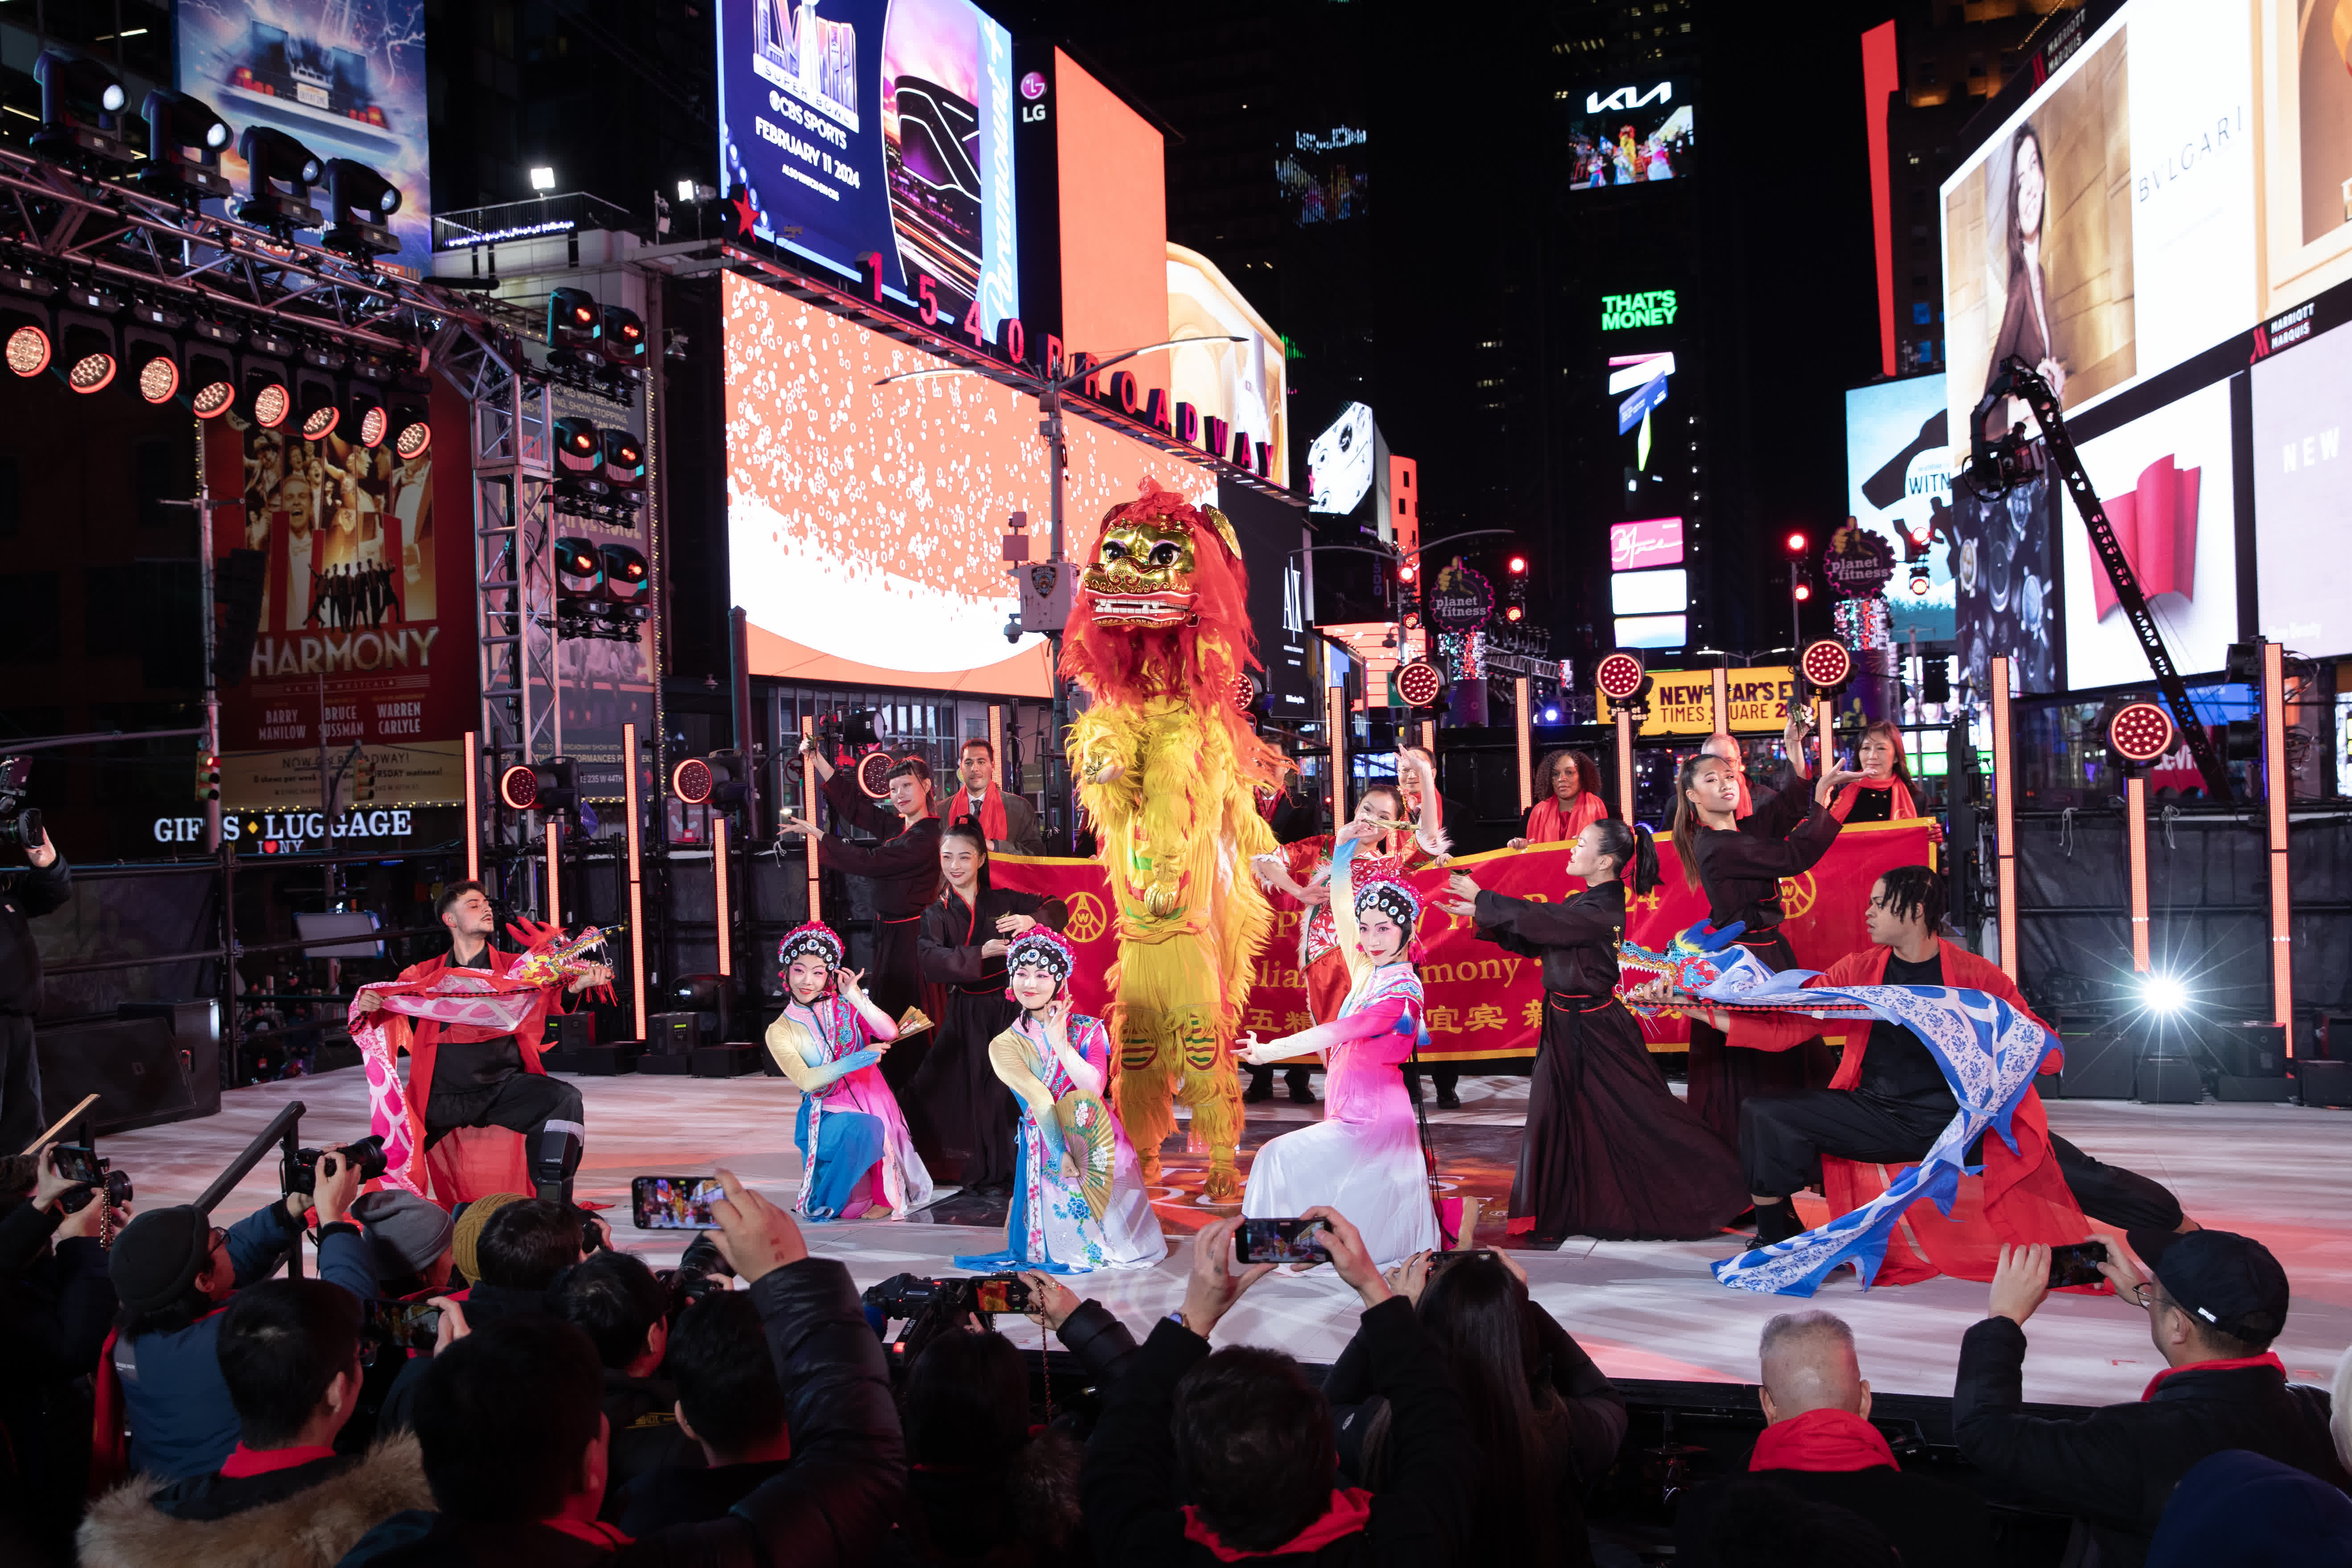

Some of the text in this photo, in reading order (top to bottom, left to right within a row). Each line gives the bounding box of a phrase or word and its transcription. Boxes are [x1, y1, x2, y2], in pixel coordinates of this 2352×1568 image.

[2048, 8, 2085, 56] MARRIOTT
[2049, 32, 2081, 74] MARQUIS
[764, 65, 850, 124] SUPER BOWL
[1587, 82, 1671, 113] KIA
[780, 96, 847, 150] CBS SPORTS
[1023, 104, 1046, 123] LG
[756, 116, 860, 189] FEBRUARY 11 2024
[2139, 105, 2241, 203] BVLGARI
[868, 251, 1024, 364] 1540
[1602, 290, 1676, 313] THAT'S
[1602, 306, 1678, 330] MONEY
[2271, 302, 2314, 333] MARRIOTT
[2271, 320, 2310, 349] MARQUIS
[2282, 426, 2340, 474] NEW
[1831, 557, 1878, 573] planet
[1838, 569, 1888, 580] fitness
[1435, 596, 1478, 610] planet
[1441, 606, 1487, 617] fitness
[250, 626, 440, 677] HARMONY
[1660, 685, 1704, 705] NEW
[266, 709, 298, 724] BARRY
[324, 705, 357, 721] BRUCE
[377, 702, 421, 718] WARREN
[1660, 706, 1704, 723] TIMES
[1711, 703, 1768, 721] UARE
[258, 724, 307, 740] MANILOW
[318, 721, 364, 739] SUSSMAN
[378, 718, 421, 735] CARLYLE
[282, 756, 311, 770] NOW
[155, 810, 411, 842] GIFS LUGGAGE
[278, 839, 304, 853] NY
